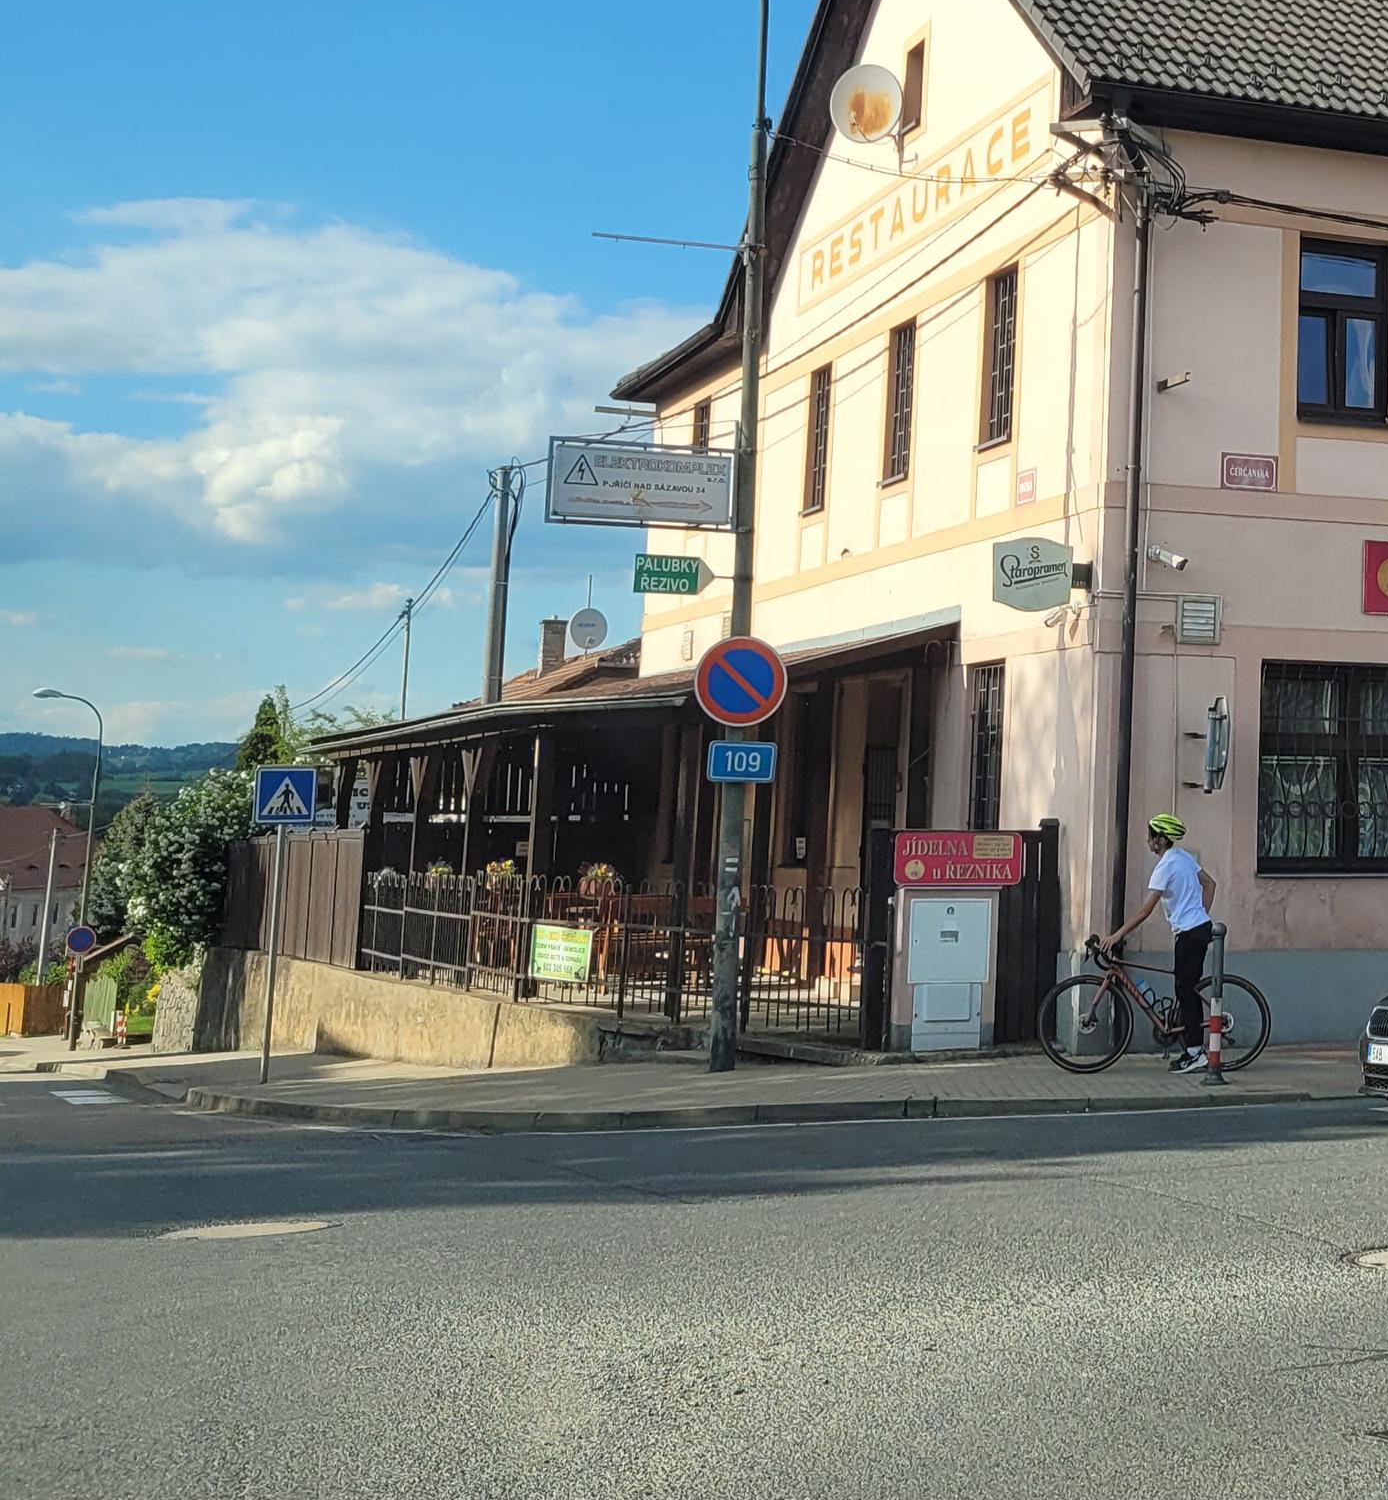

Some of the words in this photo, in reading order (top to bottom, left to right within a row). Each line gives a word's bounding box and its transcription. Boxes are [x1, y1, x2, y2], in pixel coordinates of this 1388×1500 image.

[811, 107, 1031, 289] RESTAURACE
[594, 455, 726, 476] ELEKTROKOMPLEX
[654, 483, 694, 493] SÁZAVOU
[636, 556, 699, 573] PALUBKY
[1000, 554, 1068, 587] Staropramen
[640, 574, 689, 591] ŘEZIVO
[725, 750, 761, 772] 109
[903, 837, 968, 856] JÍDELNA
[932, 868, 941, 879] u
[945, 860, 1012, 879] ŘEZNÍKA
